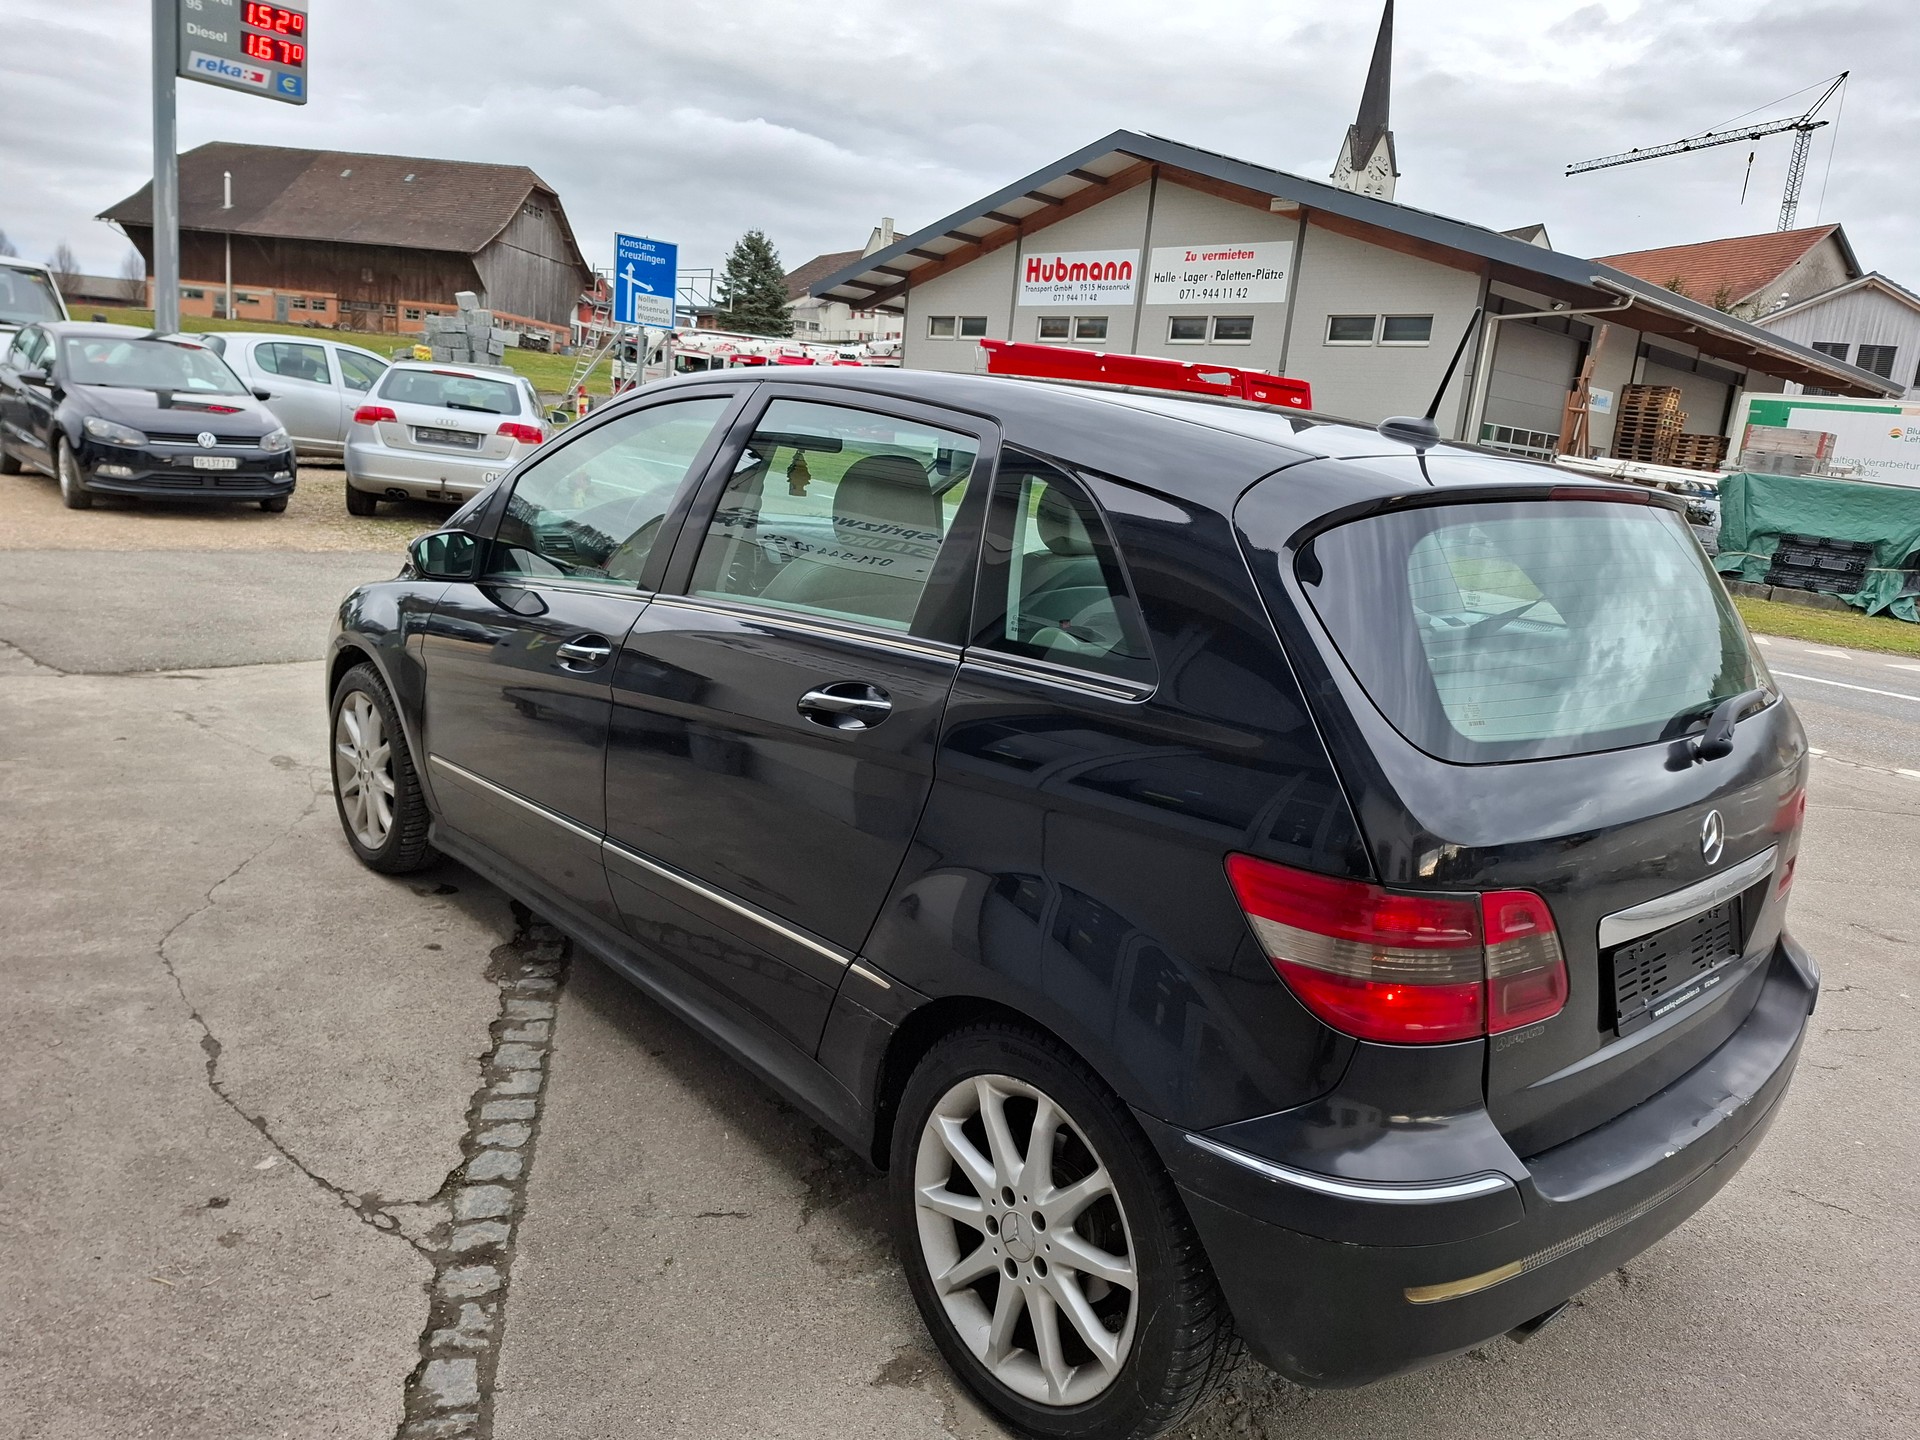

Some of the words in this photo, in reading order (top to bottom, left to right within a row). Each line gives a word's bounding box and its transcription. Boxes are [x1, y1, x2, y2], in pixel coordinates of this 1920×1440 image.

[186, 22, 228, 43] Diesel
[619, 237, 656, 252] Konstanz
[619, 248, 666, 265] Kreuzlingen
[1184, 251, 1197, 262] Zu
[1202, 248, 1255, 261] vermieten
[1026, 257, 1132, 283] Hubmann
[1154, 271, 1176, 283] Halle
[1183, 271, 1208, 285] Lager
[1215, 268, 1284, 281] Paletten-Plätze
[1025, 286, 1053, 295] Transport
[1054, 284, 1073, 292] GmbH
[1080, 283, 1096, 292] 9515
[1097, 283, 1130, 291] Hosenruck
[1222, 287, 1233, 299] 11
[1236, 287, 1249, 299] 42
[638, 295, 659, 305] Nollen
[1053, 294, 1065, 302] 071
[1080, 293, 1087, 301] 11
[1089, 293, 1098, 301] 42
[637, 302, 670, 315] Hosenruck
[1831, 456, 1861, 466] altige
[485, 472, 500, 483] CH
